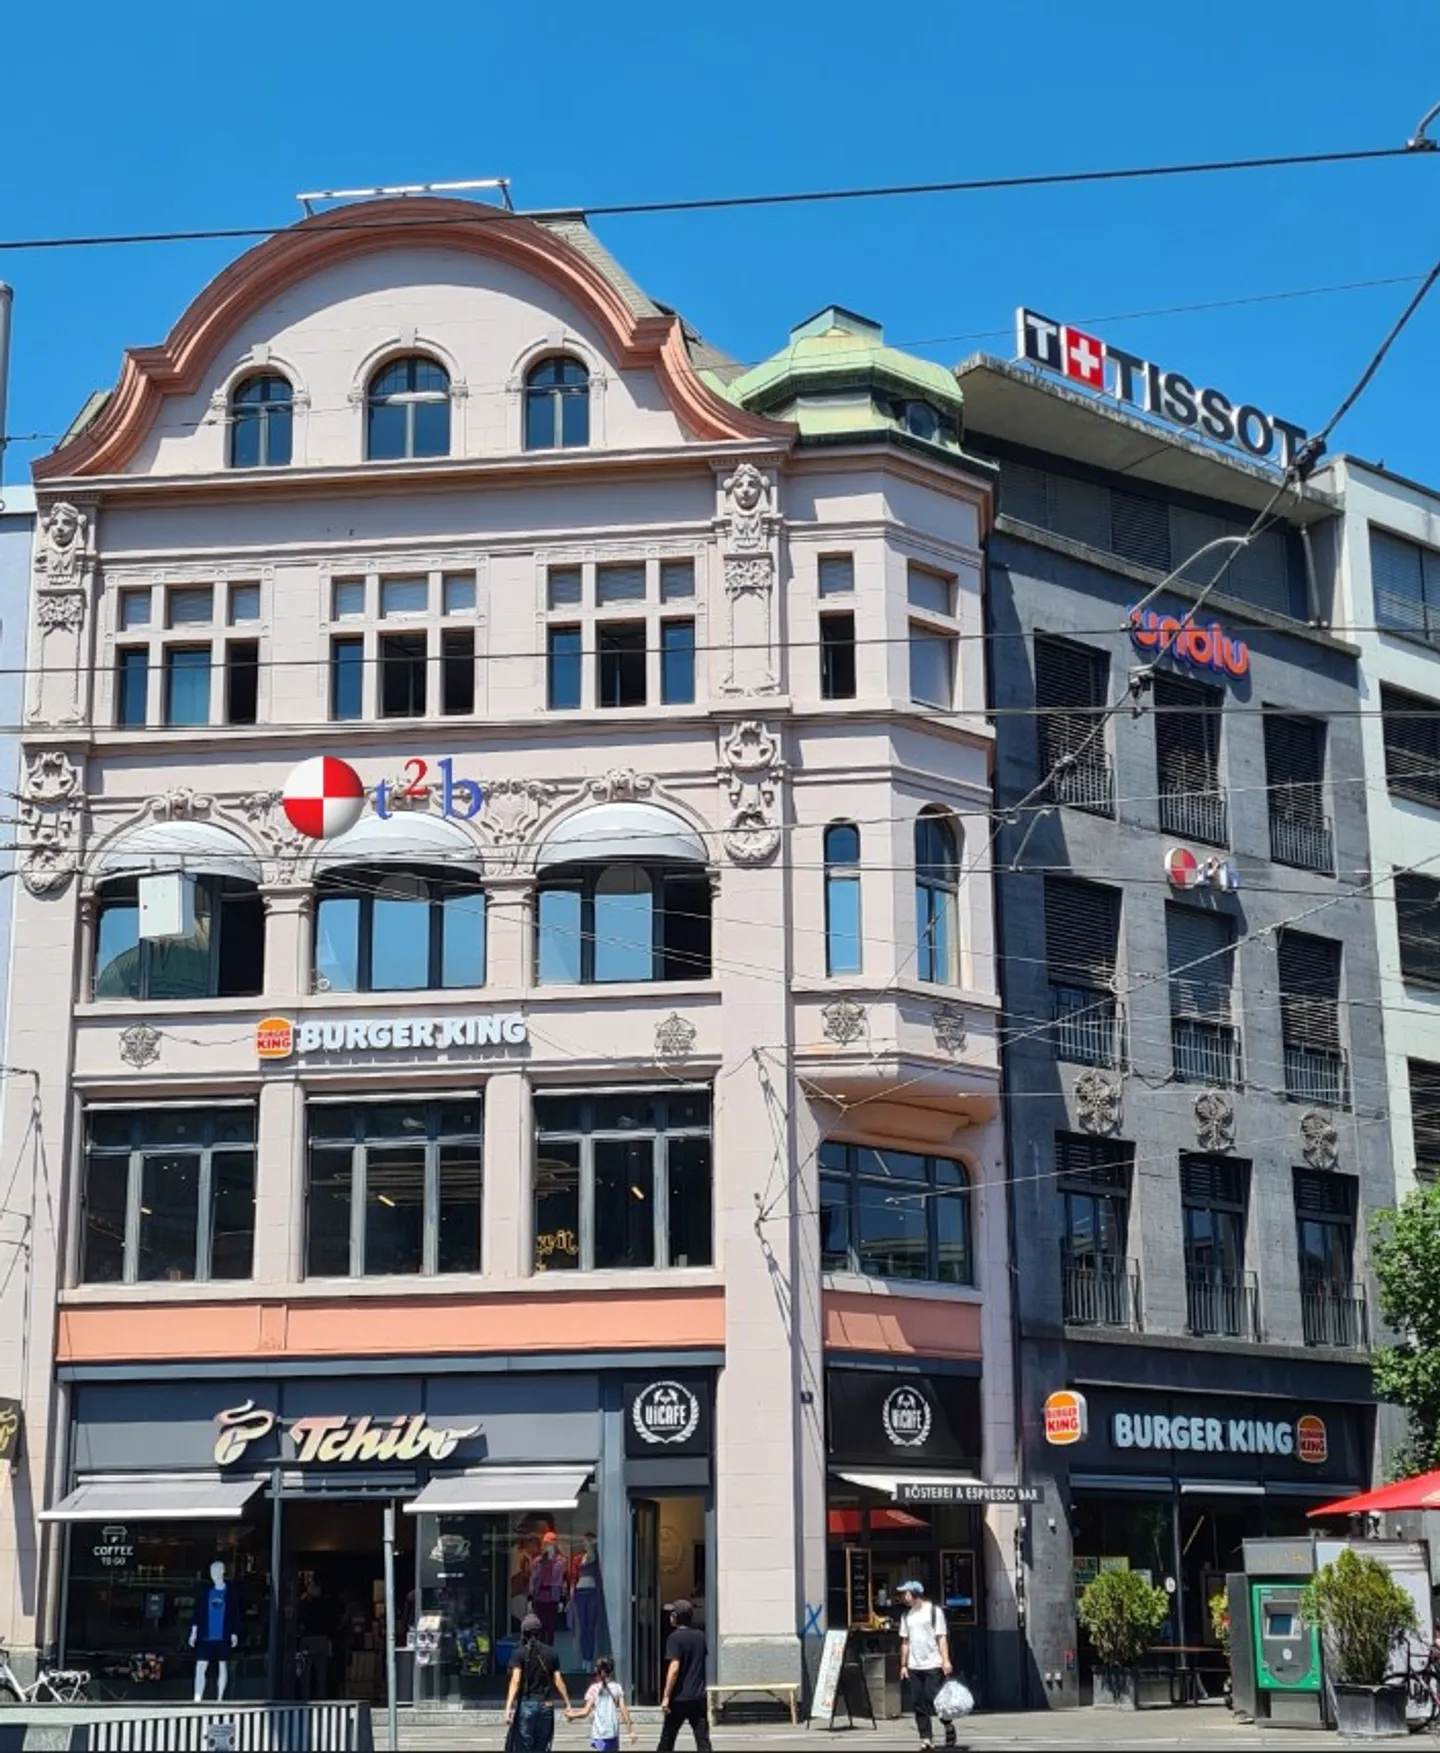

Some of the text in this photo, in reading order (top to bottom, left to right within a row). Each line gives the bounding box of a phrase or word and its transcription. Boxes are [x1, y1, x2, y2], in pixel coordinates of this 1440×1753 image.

[1102, 342, 1307, 470] TISSOT
[1128, 605, 1250, 677] unblu
[257, 1039, 291, 1049] KING
[300, 1012, 527, 1050] BURGER KING
[289, 1413, 484, 1462] Tchibo
[1048, 1417, 1079, 1432] KING
[1113, 1413, 1294, 1455] BURGER KING
[904, 1483, 953, 1499] RÖSTEREI
[965, 1486, 1016, 1501] ESPRESSO
[1018, 1488, 1038, 1500] BAR
[92, 1545, 134, 1556] COFFEE
